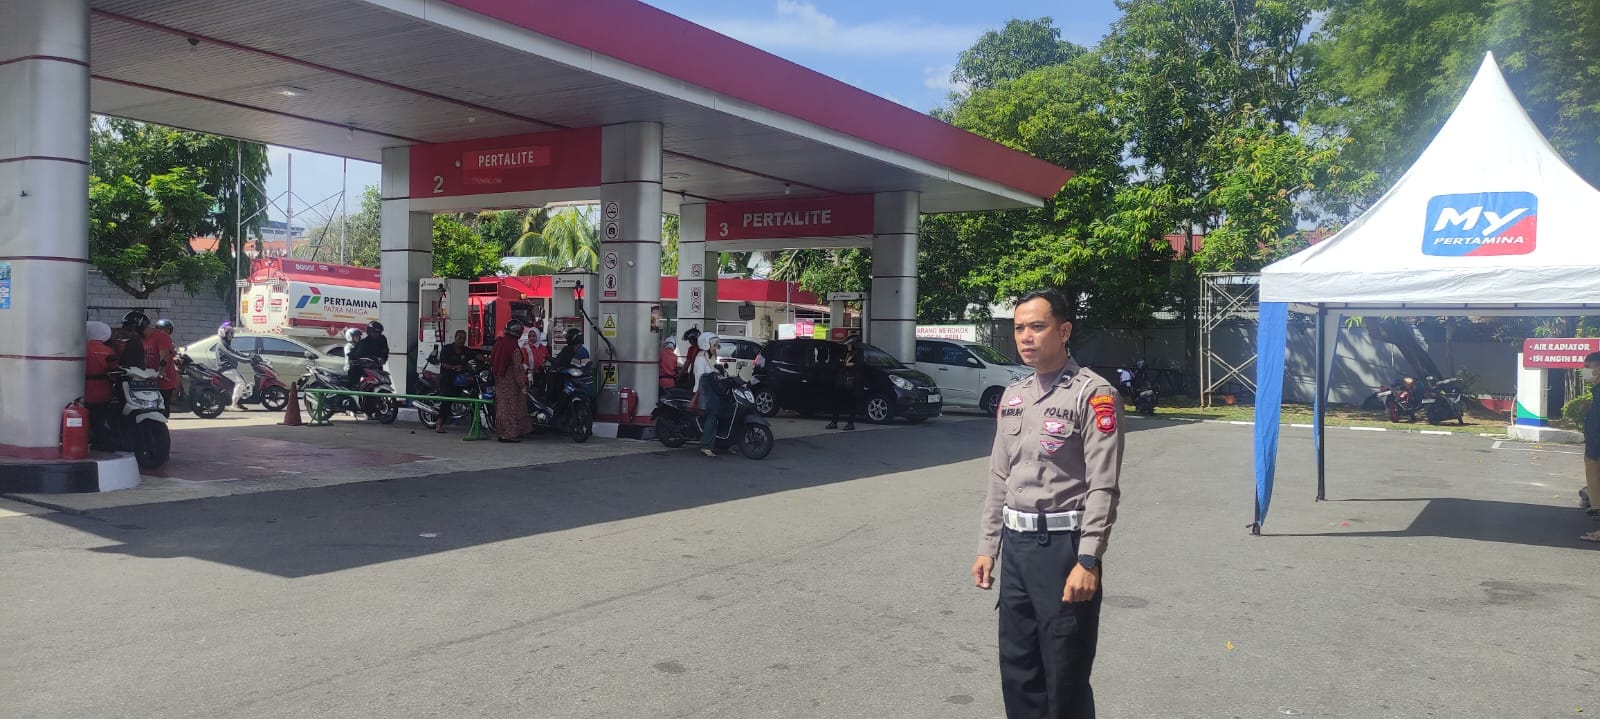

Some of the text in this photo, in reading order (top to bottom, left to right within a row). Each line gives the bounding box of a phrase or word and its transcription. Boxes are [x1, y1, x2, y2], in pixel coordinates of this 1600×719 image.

[478, 151, 534, 168] PERTALITE
[433, 176, 444, 194] 2
[743, 209, 832, 227] PERTALITE
[1432, 206, 1530, 237] My
[719, 222, 729, 237] 3
[1433, 236, 1525, 245] PERTAMINA
[324, 296, 378, 309] PERTAMINA
[323, 305, 344, 314] PATRA
[1533, 343, 1590, 351] AIR RADIATOR
[1544, 355, 1571, 363] ANGIN
[1043, 407, 1074, 420] POLRI
